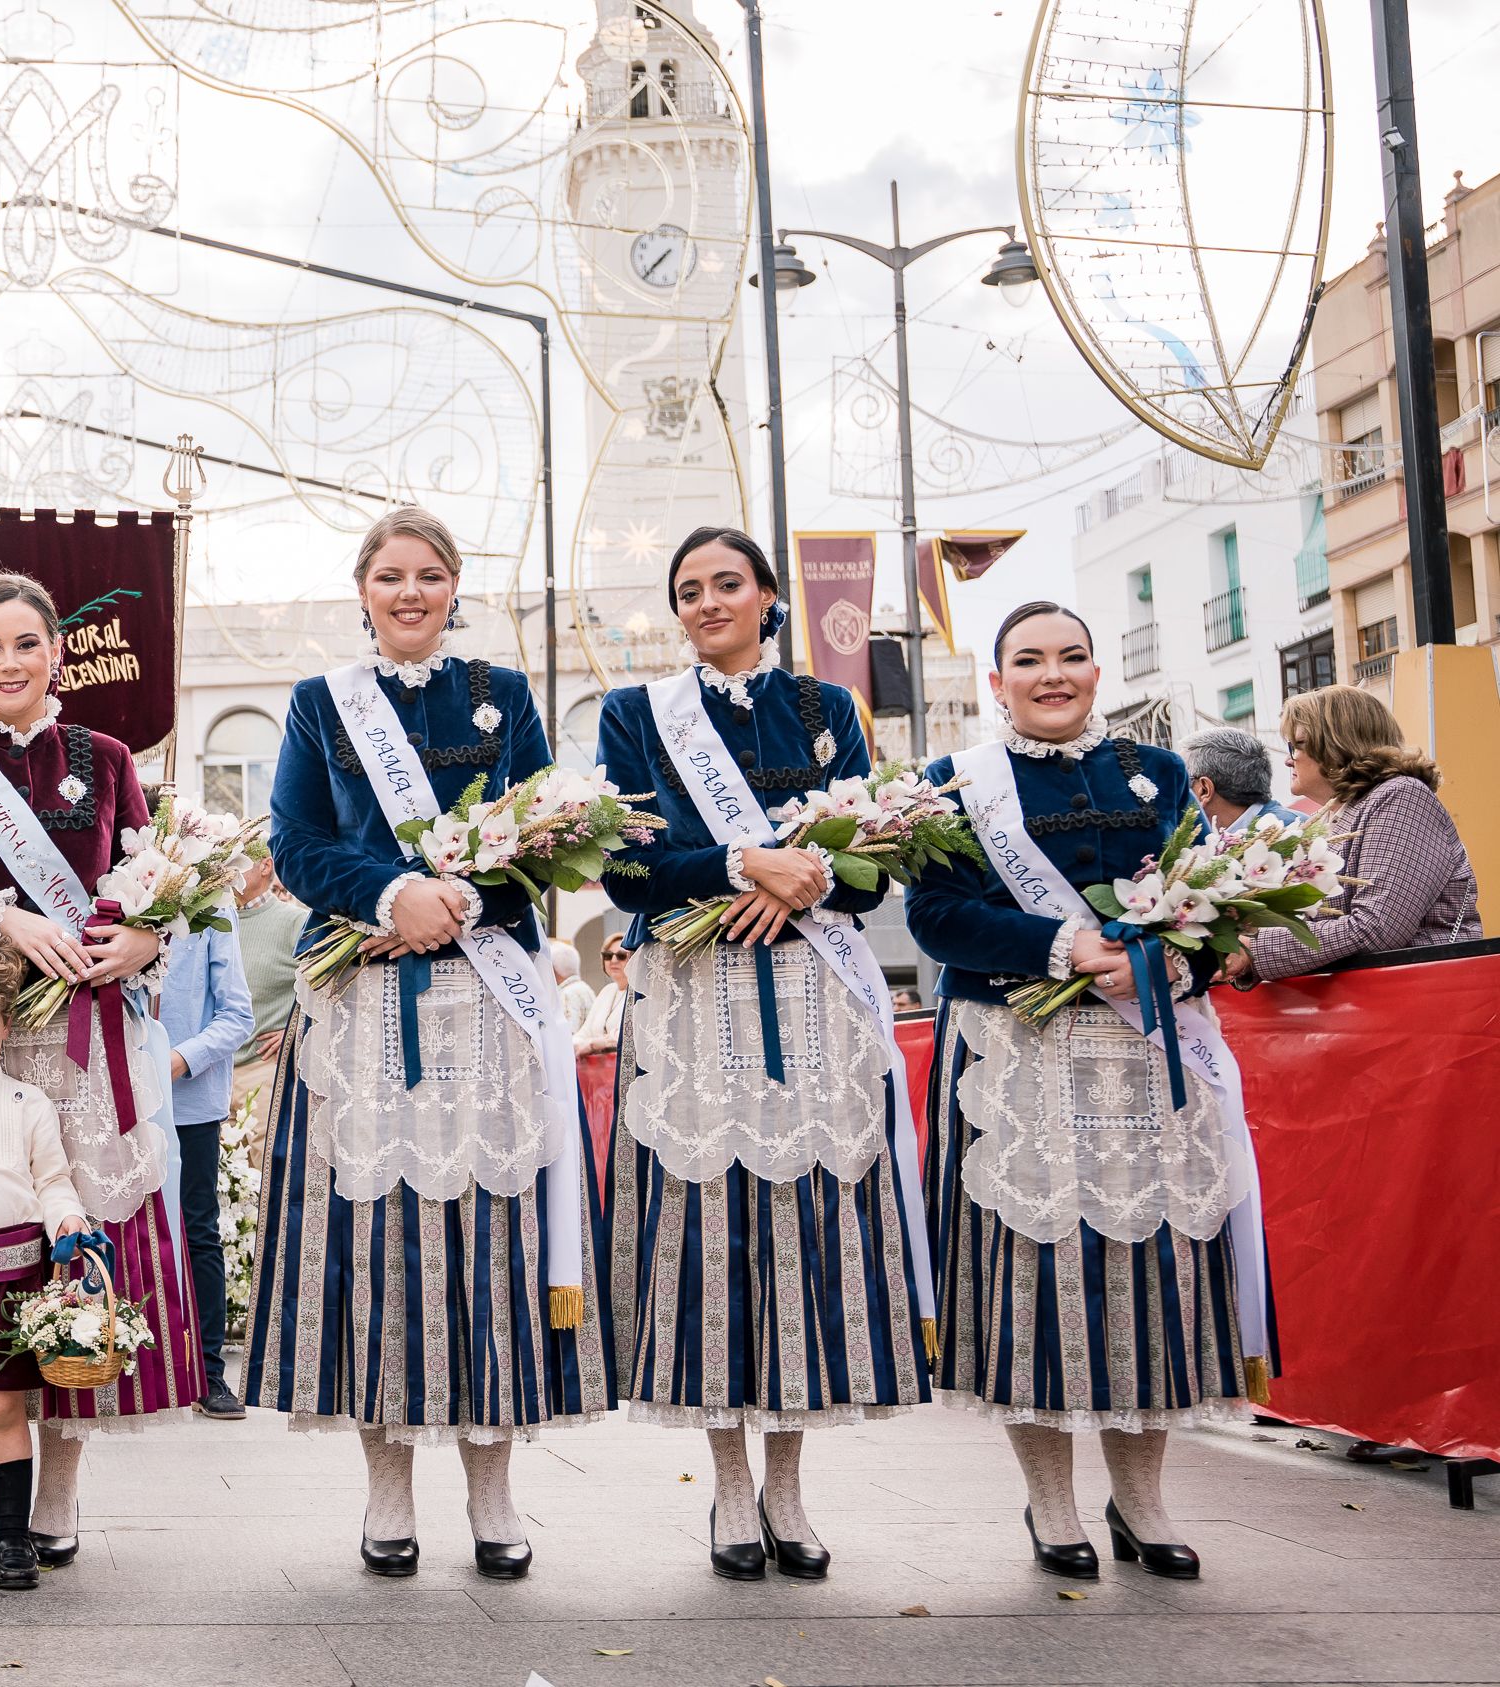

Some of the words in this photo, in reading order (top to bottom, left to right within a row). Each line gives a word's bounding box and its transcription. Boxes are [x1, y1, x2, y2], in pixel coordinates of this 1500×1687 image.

[67, 617, 131, 655] CORAL
[364, 727, 412, 796] DAMA
[689, 751, 743, 824] DAMA
[990, 830, 1050, 905] DAMA
[44, 872, 85, 933] MAYOR
[501, 972, 542, 1018] 2026
